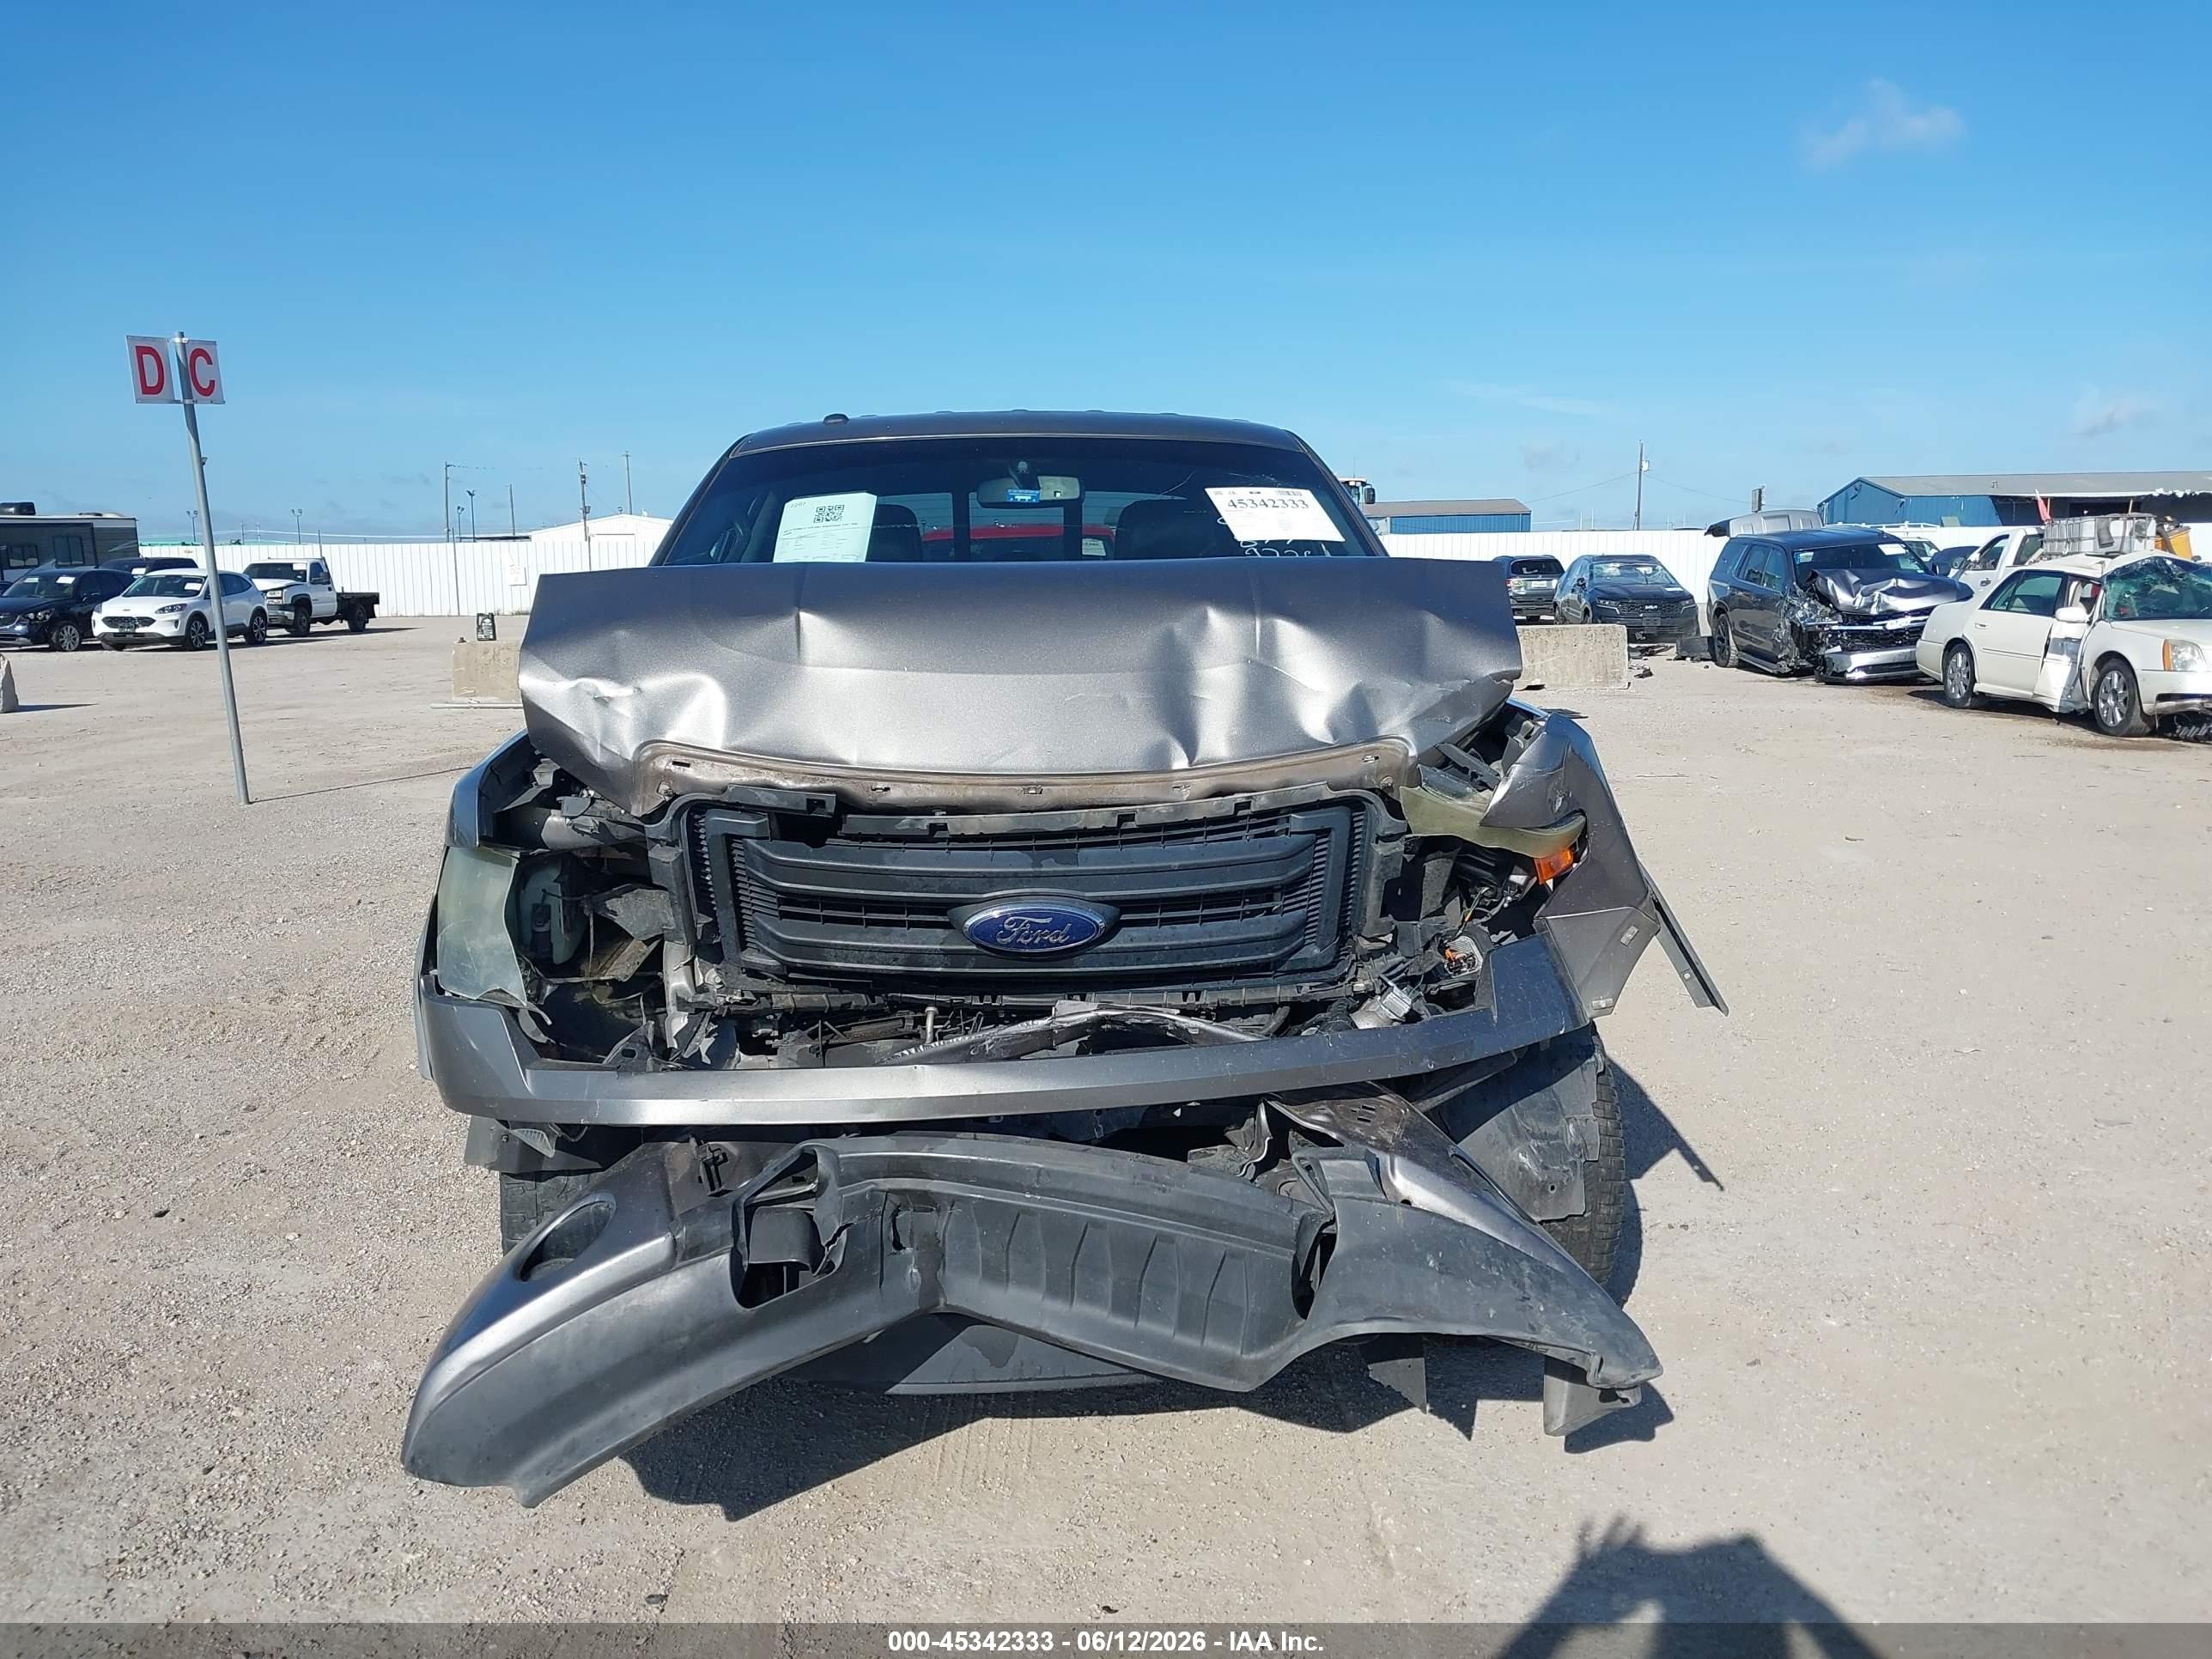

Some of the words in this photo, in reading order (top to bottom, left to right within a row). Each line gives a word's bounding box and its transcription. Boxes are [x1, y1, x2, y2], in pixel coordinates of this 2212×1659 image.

[135, 345, 165, 395] D
[189, 348, 216, 397] C
[1227, 498, 1310, 509] 45342333
[996, 916, 1073, 945] Ford
